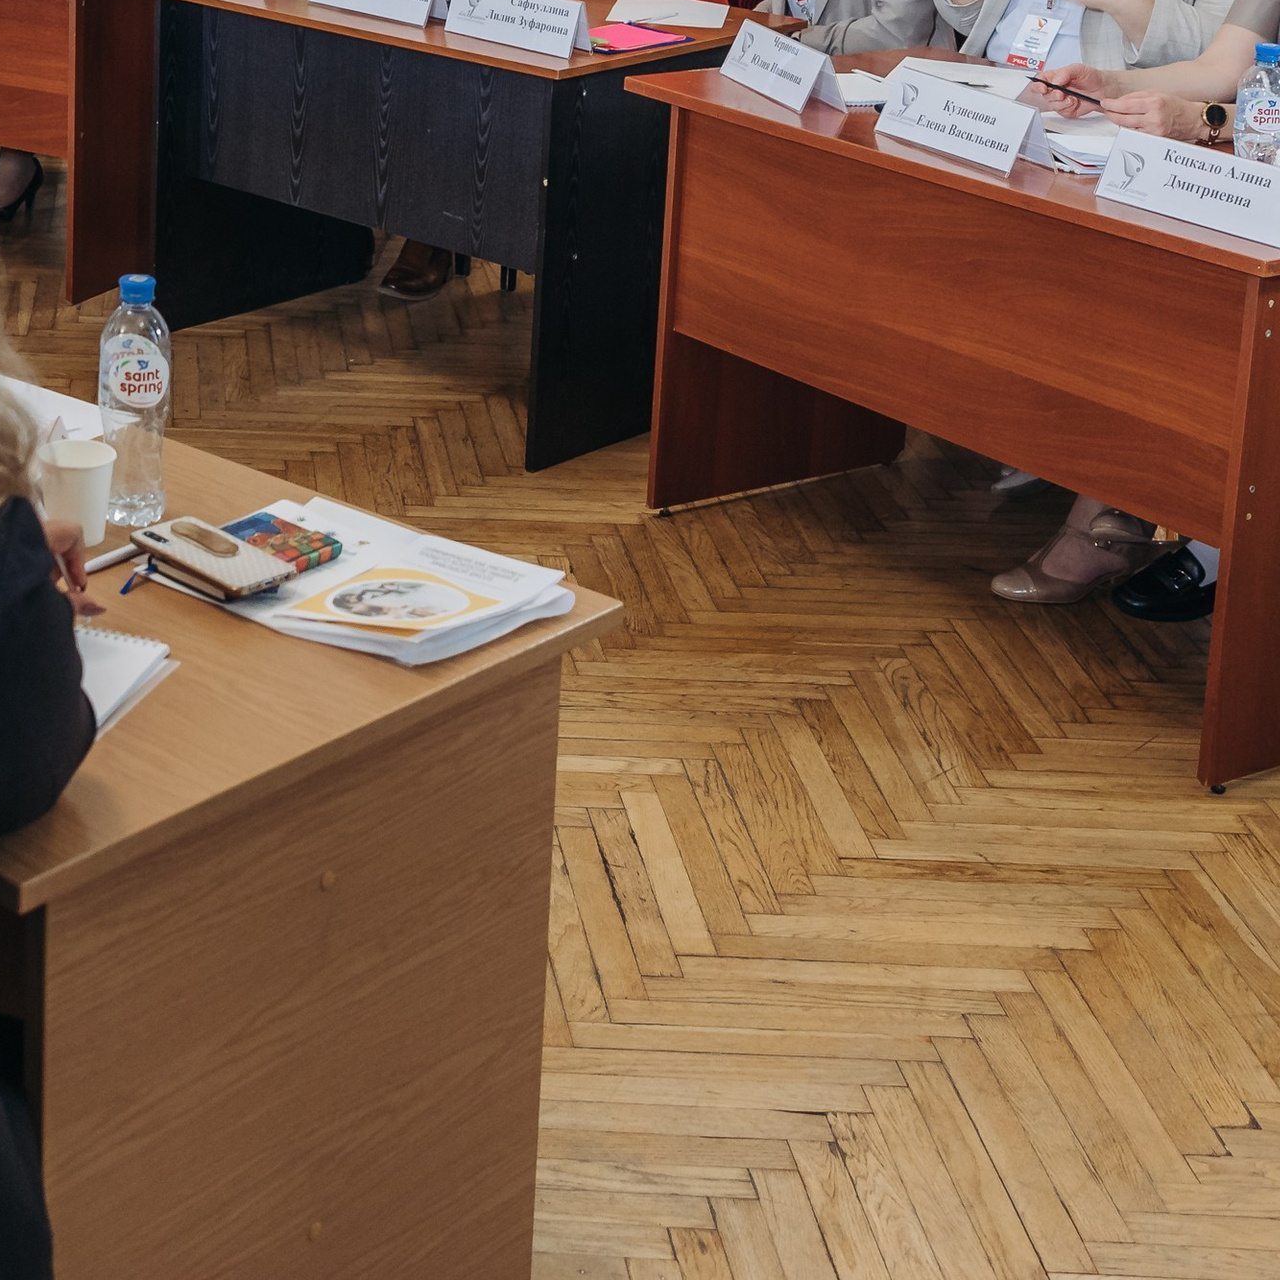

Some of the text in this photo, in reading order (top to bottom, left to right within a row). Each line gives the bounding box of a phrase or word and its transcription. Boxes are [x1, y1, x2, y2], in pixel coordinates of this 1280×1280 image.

[485, 8, 516, 24] Лилия
[518, 15, 569, 36] Зуфаровна
[773, 35, 800, 56] Чернова
[750, 53, 771, 71] Юлия
[943, 99, 997, 126] Кузнецова
[916, 114, 947, 133] Елена
[947, 123, 1010, 153] Васильевна
[1163, 148, 1272, 188] Кецкало Алина
[1163, 173, 1252, 209] Дмитриевна
[120, 380, 163, 396] spring
[125, 369, 160, 382] saint
